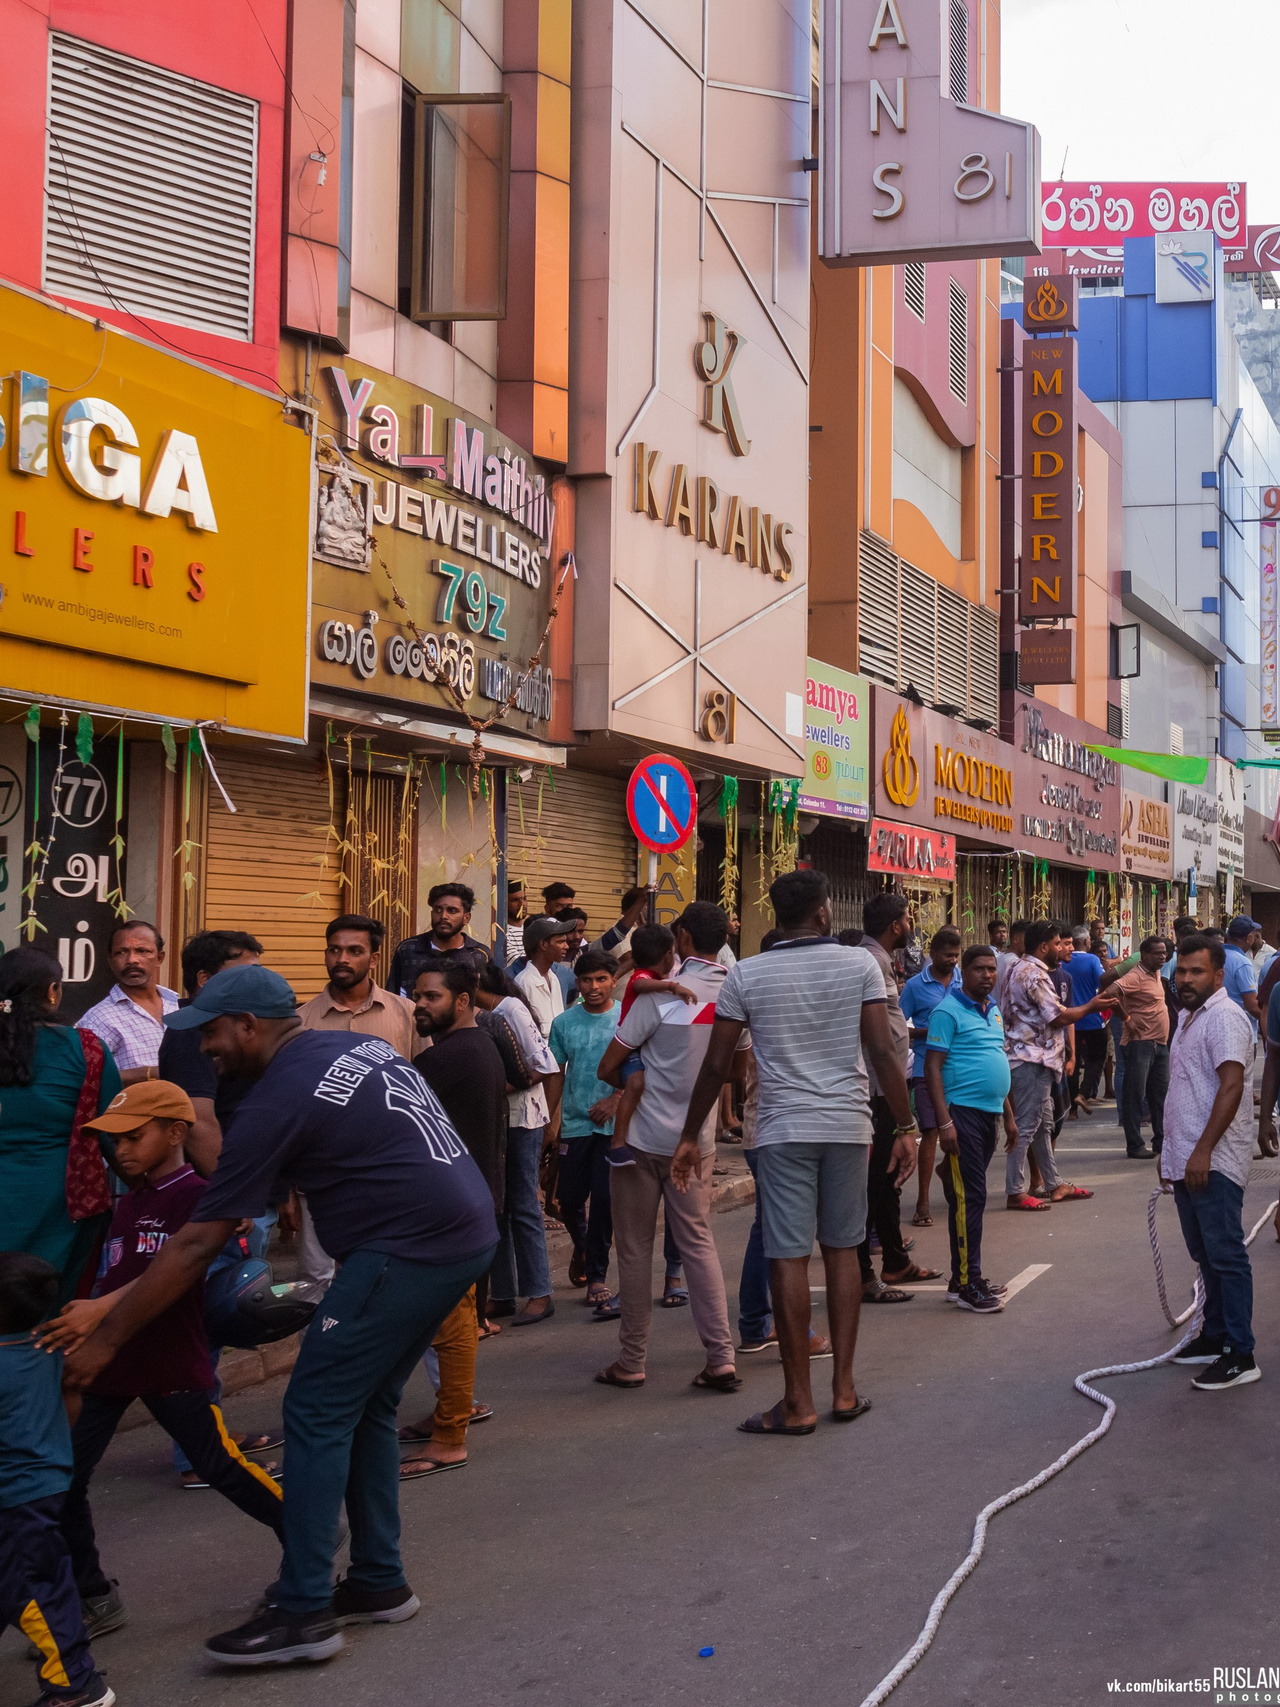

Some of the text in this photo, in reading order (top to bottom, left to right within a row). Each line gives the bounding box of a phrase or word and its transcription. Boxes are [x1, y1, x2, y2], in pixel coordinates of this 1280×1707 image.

[953, 151, 1013, 202] 81
[1041, 182, 1241, 240] රත්න මහල්
[1032, 266, 1050, 277] 115
[1031, 348, 1064, 360] NEW
[0, 370, 219, 534] IGA
[1031, 367, 1064, 604] MODERN
[374, 481, 543, 590] JEWELLERS
[633, 441, 795, 583] KARANS
[22, 590, 184, 640] www ambigajewellers.com
[699, 689, 738, 745] 81
[806, 678, 859, 726] amya
[806, 723, 851, 751] ewellers
[815, 754, 828, 775] 83
[934, 742, 1013, 808] MODERN
[61, 775, 102, 818] 77
[934, 795, 979, 823] JEWELLERS
[1137, 799, 1170, 839] ASHA
[313, 1054, 374, 1107] NEW
